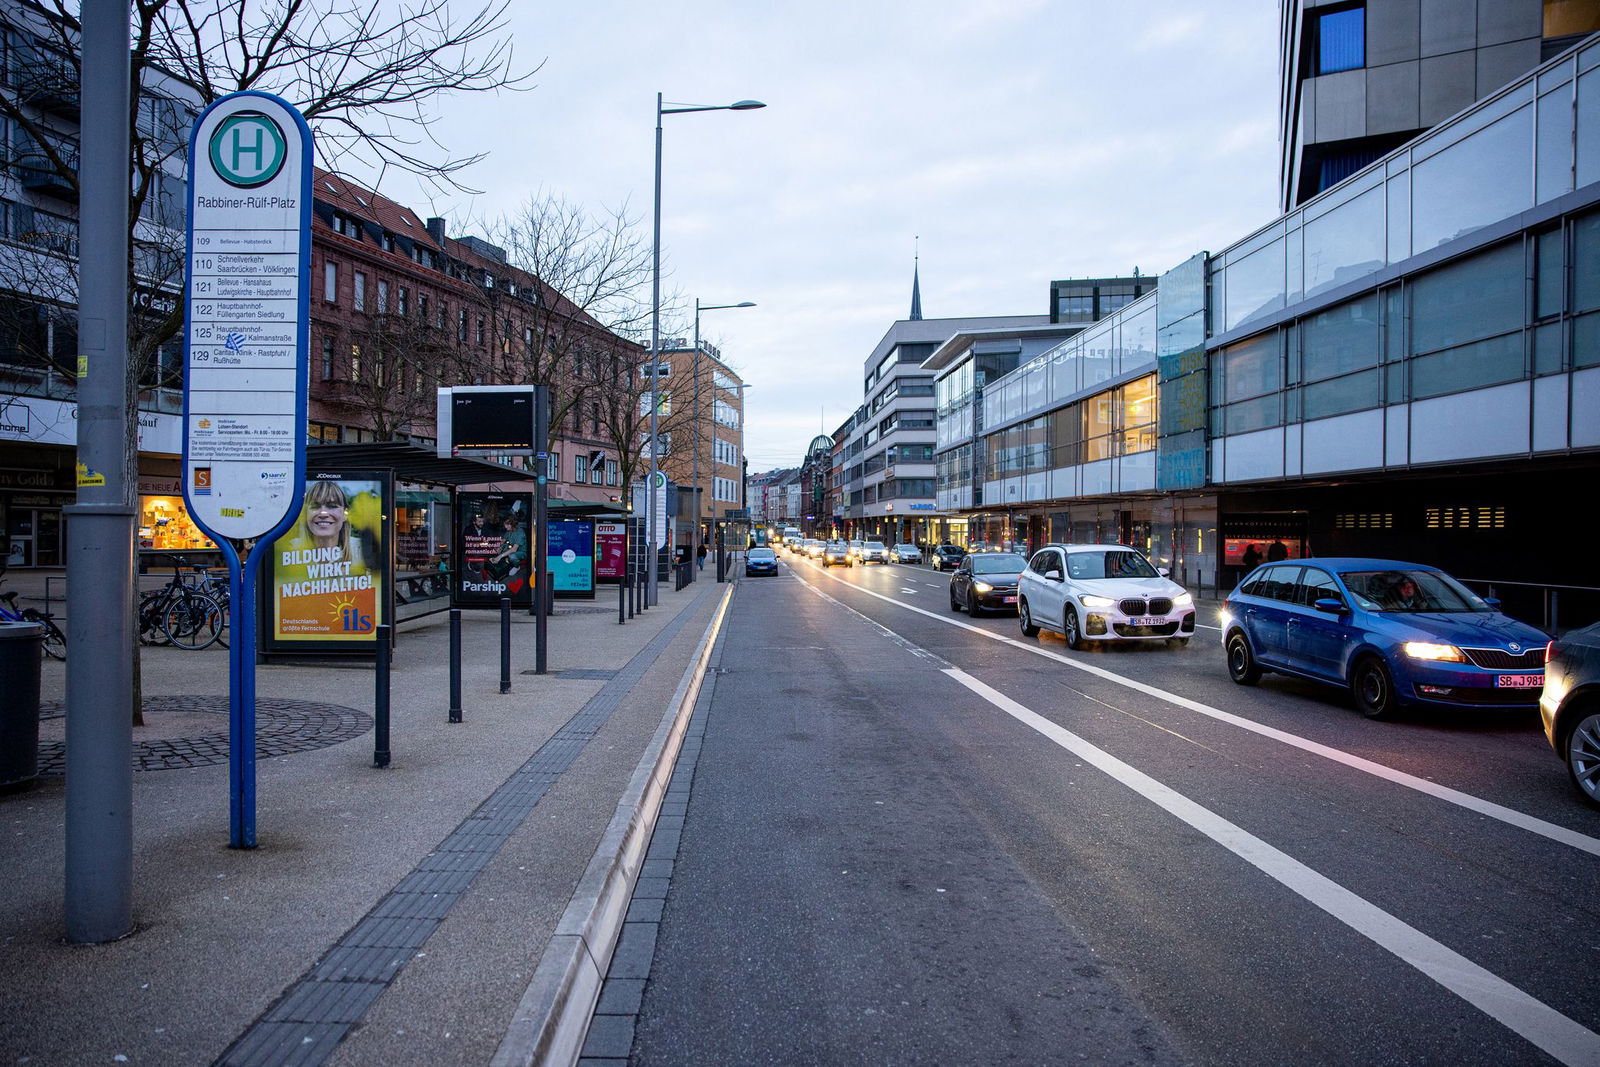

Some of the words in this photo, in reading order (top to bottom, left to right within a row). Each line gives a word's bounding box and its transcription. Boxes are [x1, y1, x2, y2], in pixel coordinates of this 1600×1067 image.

[232, 128, 263, 171] H
[197, 196, 296, 208] Rabbiner-Rülf-Platz
[217, 254, 264, 264] Schnellverkehr
[196, 260, 212, 270] 110
[217, 264, 258, 273] Saarbrücken
[262, 265, 296, 274] Völklingen
[196, 282, 212, 292] 121
[217, 288, 252, 297] Ludwigskirche
[256, 288, 292, 296] Hauptbahnhof
[196, 304, 213, 315] 122
[216, 311, 256, 320] Füllengarten
[257, 311, 285, 320] Siedlung
[195, 328, 212, 338] 125
[192, 350, 210, 361] 129
[258, 350, 286, 358] Rastpfuhl
[198, 472, 207, 486] S
[152, 484, 172, 492] NEUE
[282, 546, 341, 566] BILDUNG
[306, 561, 352, 579] WIRKT
[282, 574, 372, 598] NACHHALTIG!
[462, 580, 506, 594] Parship
[342, 608, 372, 632] ils
[1500, 676, 1512, 686] SB
[1518, 676, 1525, 686] J
[1526, 676, 1545, 686] 981
